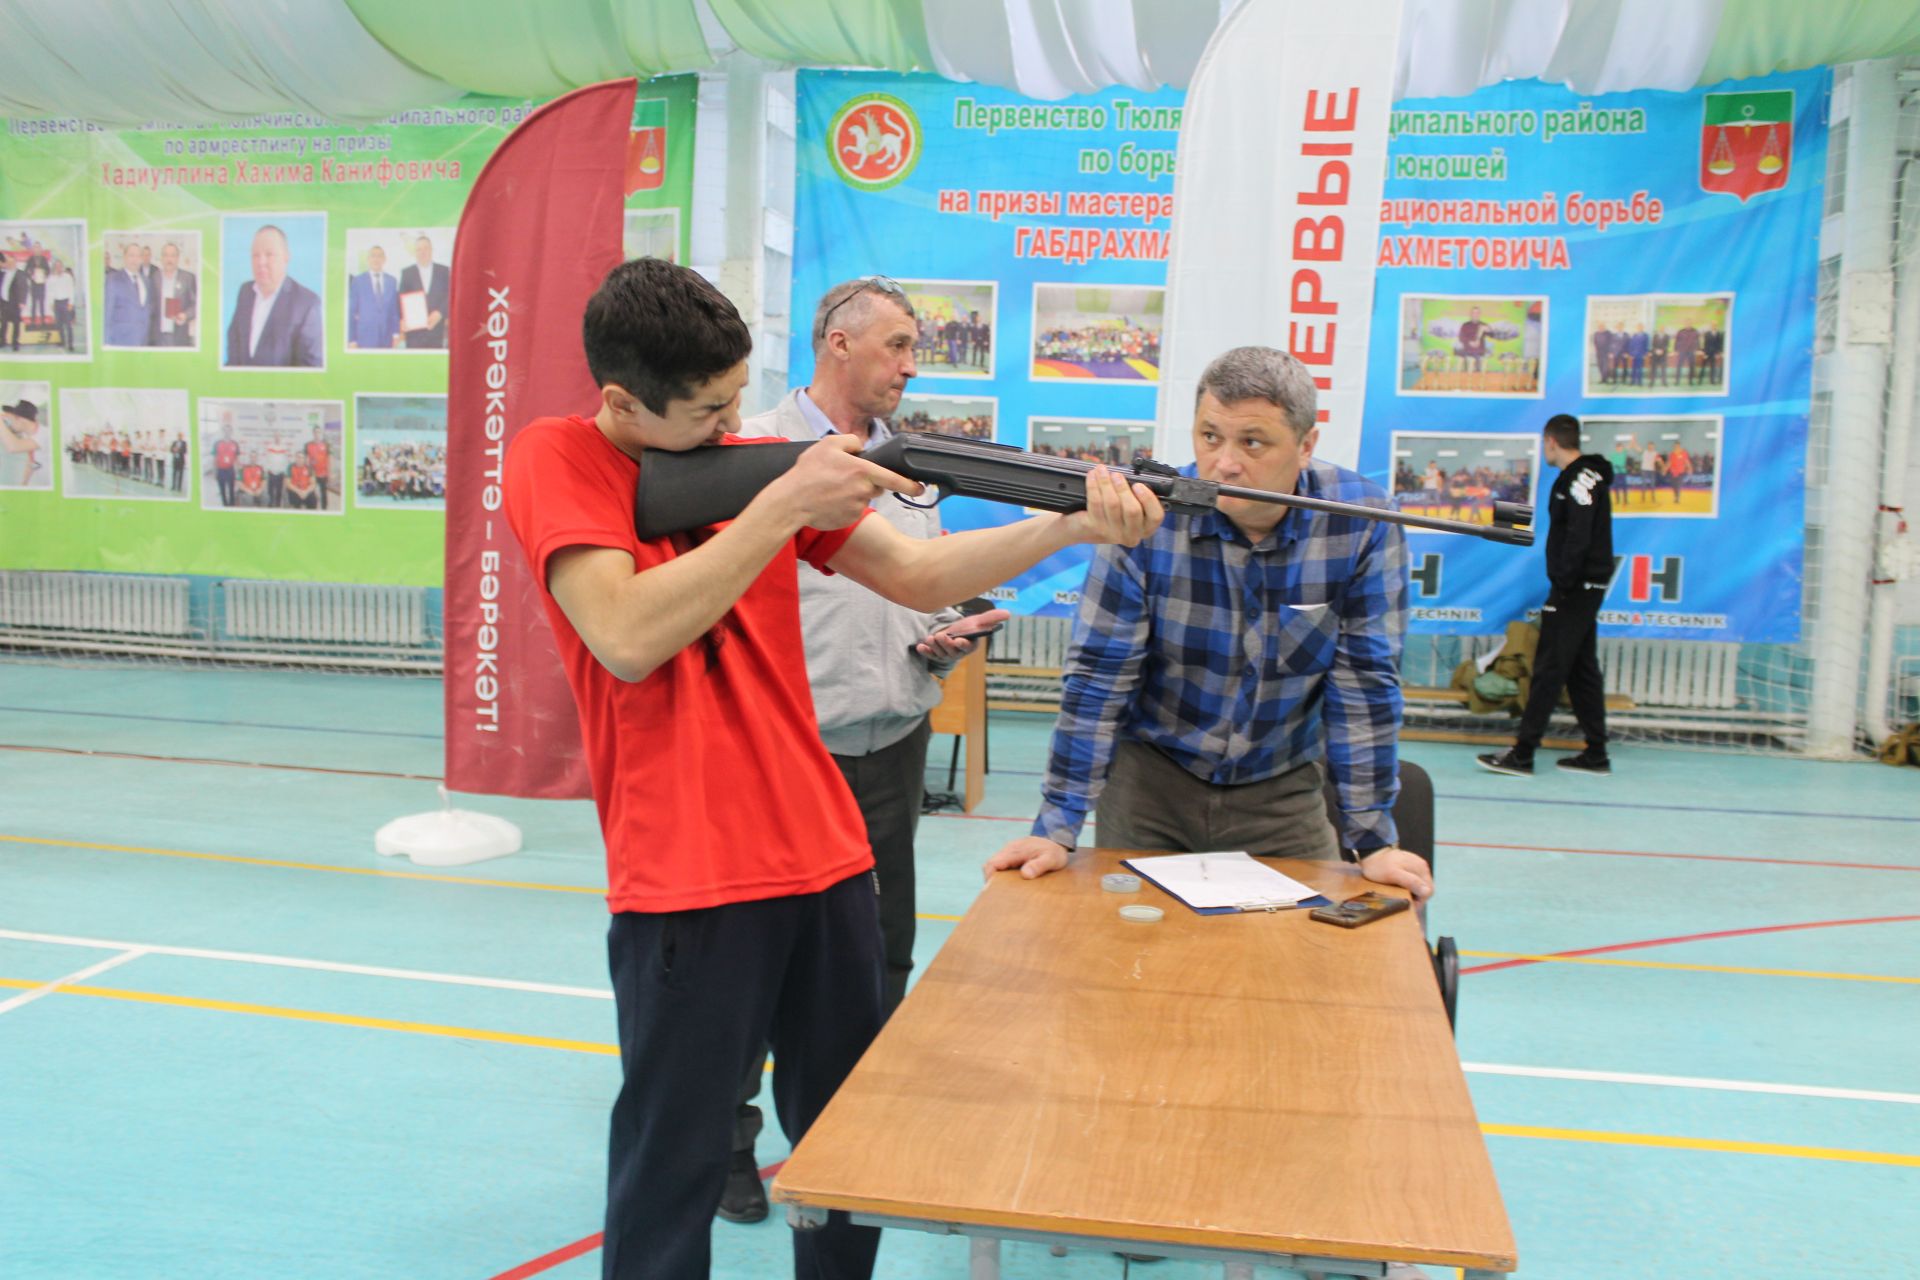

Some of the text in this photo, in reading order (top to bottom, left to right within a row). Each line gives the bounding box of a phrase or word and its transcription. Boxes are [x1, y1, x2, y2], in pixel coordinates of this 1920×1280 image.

[502, 100, 532, 126] рай
[955, 100, 1645, 141] Первенство Тюля ципального района
[165, 139, 183, 153] по
[313, 135, 332, 152] на
[337, 134, 391, 152] призы
[236, 158, 314, 184] Хакима
[321, 156, 460, 187] Канифовича
[1080, 150, 1111, 173] по
[1119, 143, 1176, 180] борь
[1397, 149, 1505, 178] юношей
[939, 190, 1662, 231] на призы мастера ациональной борьбе
[1377, 237, 1570, 269] АХМЕТОВИЧА
